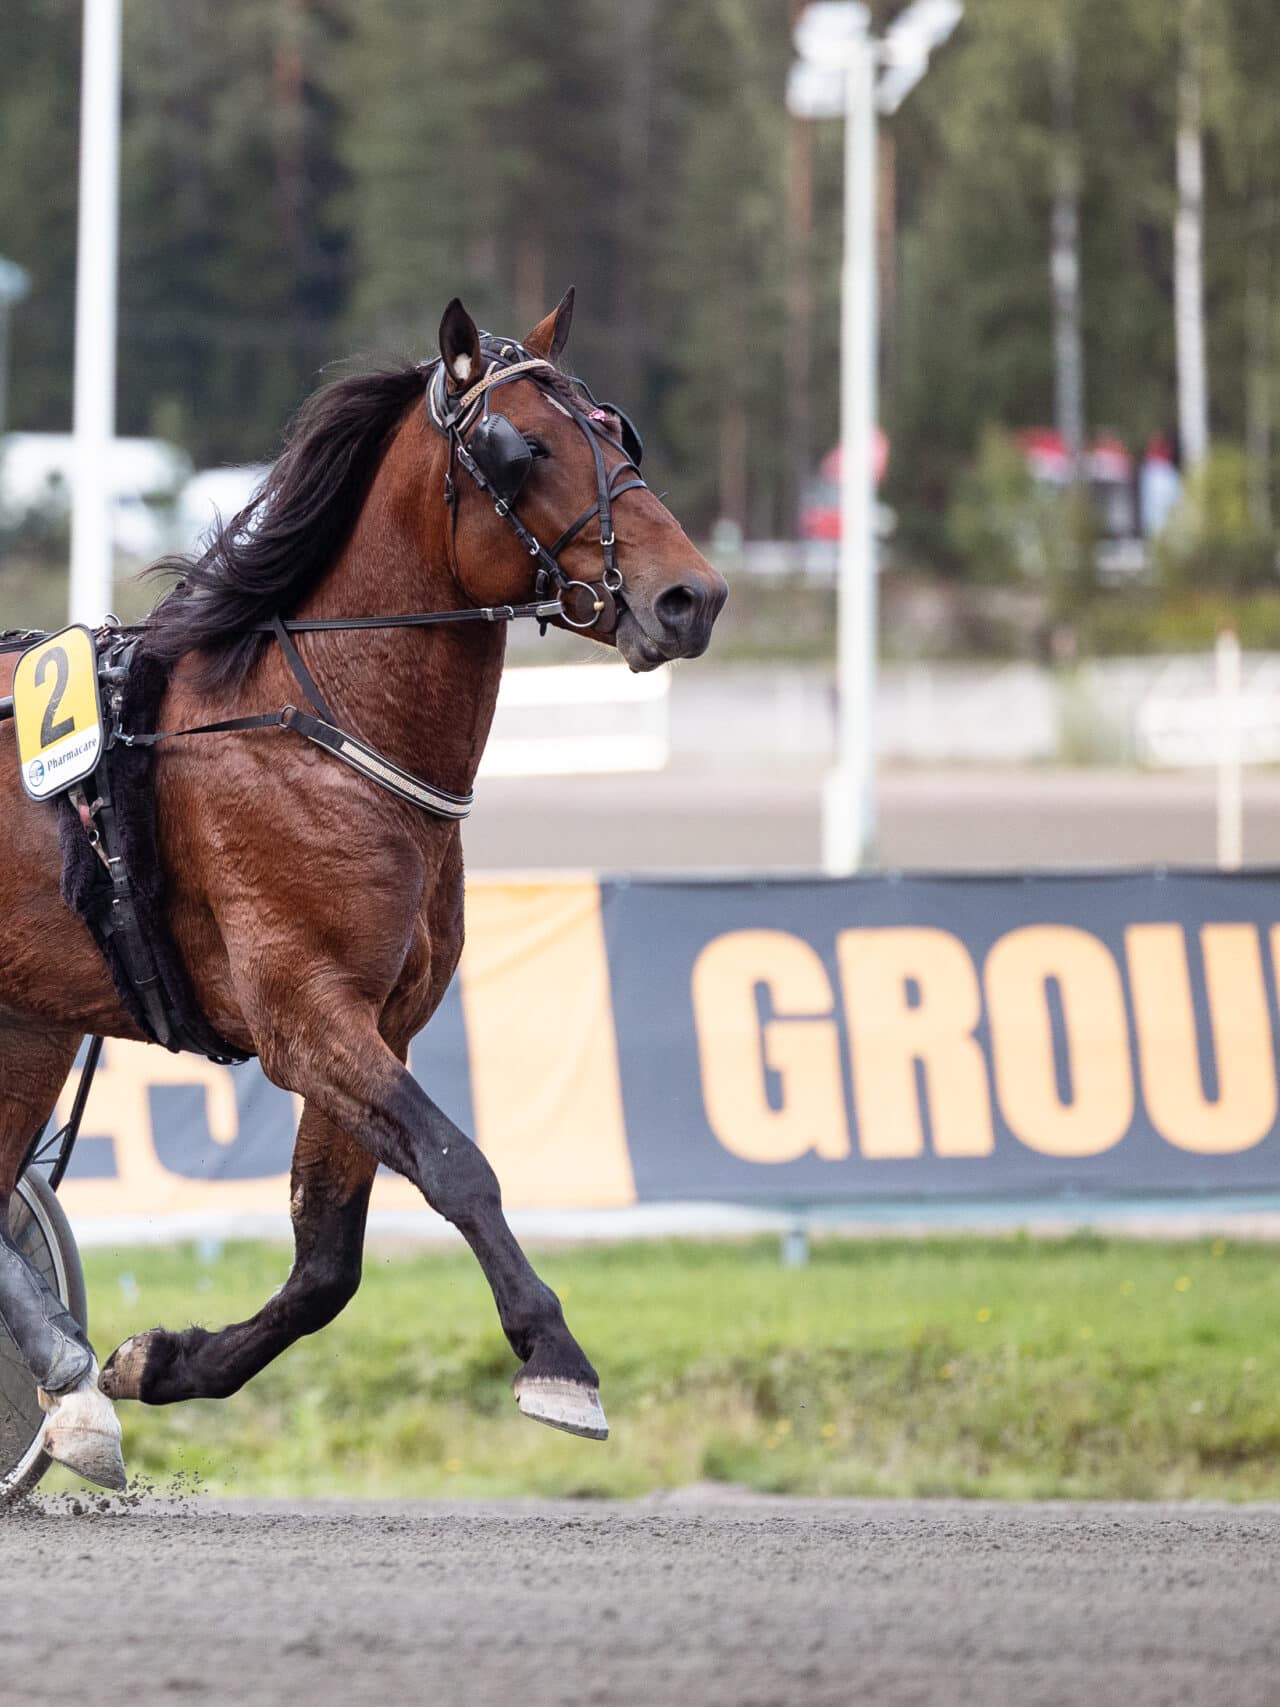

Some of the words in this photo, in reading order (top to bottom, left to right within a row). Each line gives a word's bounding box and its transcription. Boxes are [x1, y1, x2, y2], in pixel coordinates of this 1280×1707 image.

[34, 646, 76, 748] 2
[47, 738, 97, 772] Pharmacare
[691, 922, 1280, 1164] GROU
